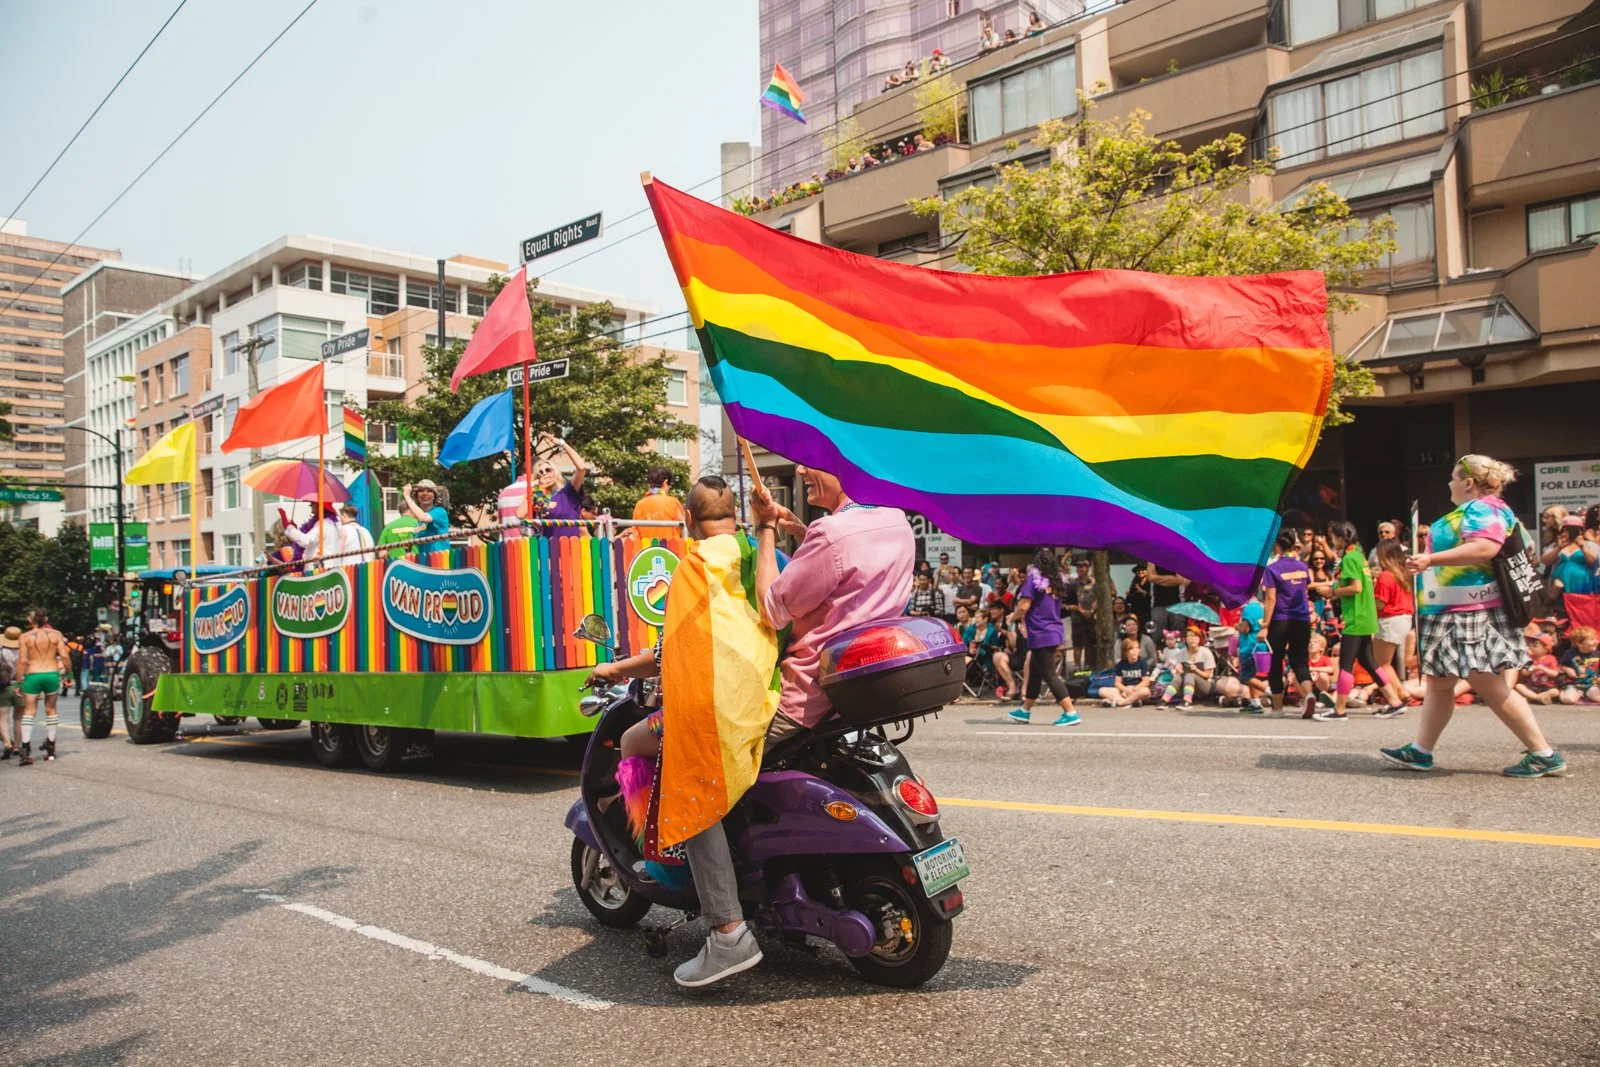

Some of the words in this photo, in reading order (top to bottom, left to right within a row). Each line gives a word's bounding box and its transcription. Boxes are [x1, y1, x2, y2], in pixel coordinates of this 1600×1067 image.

[525, 234, 551, 257] Equal
[553, 225, 583, 247] Rights
[585, 217, 598, 227] Road
[323, 342, 336, 356] City
[337, 335, 356, 350] Pride
[512, 370, 525, 382] Cit
[529, 365, 551, 379] Pride
[1539, 466, 1570, 474] CBRE
[14, 492, 40, 500] Nicola
[1541, 481, 1564, 490] FOR
[1566, 479, 1600, 489] LEASE
[276, 591, 300, 621] VAN
[389, 576, 422, 619] VAN
[195, 616, 213, 640] VAN
[924, 848, 957, 872] MOTORINO
[930, 859, 960, 882] ELECTRIC
